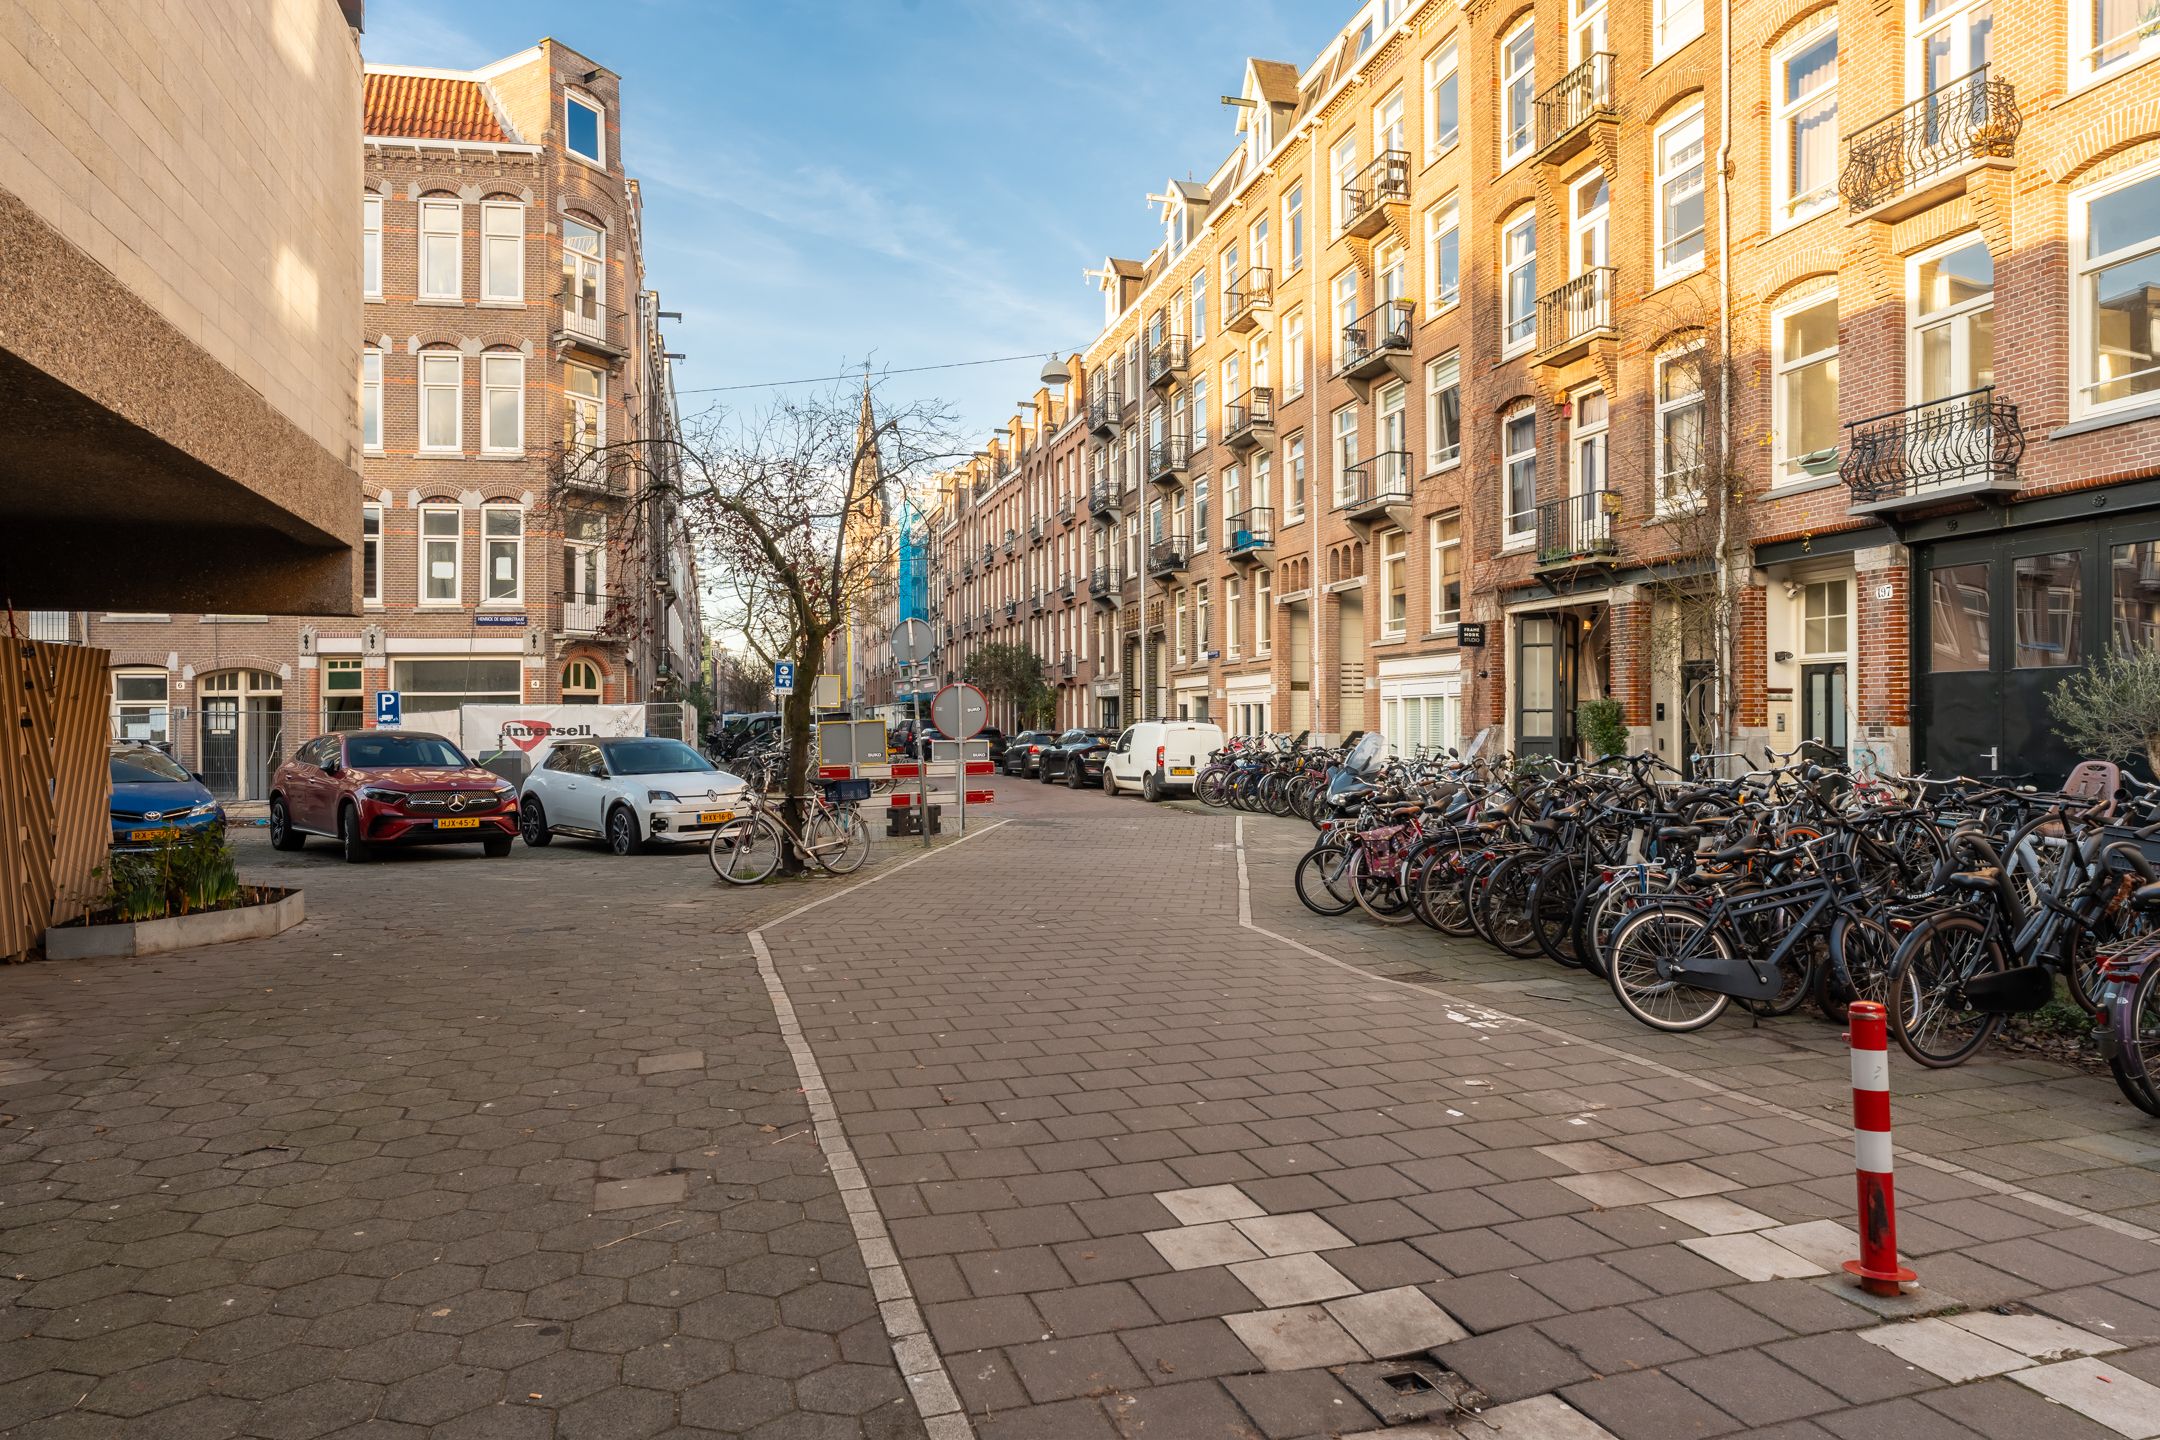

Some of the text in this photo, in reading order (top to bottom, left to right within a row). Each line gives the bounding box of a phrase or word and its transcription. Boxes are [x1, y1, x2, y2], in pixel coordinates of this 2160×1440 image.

[1878, 586, 1891, 598] 197
[381, 693, 395, 711] P
[505, 724, 592, 737] intersell
[440, 819, 476, 827] HJX-45-Z
[703, 813, 732, 821] HXX-16-D
